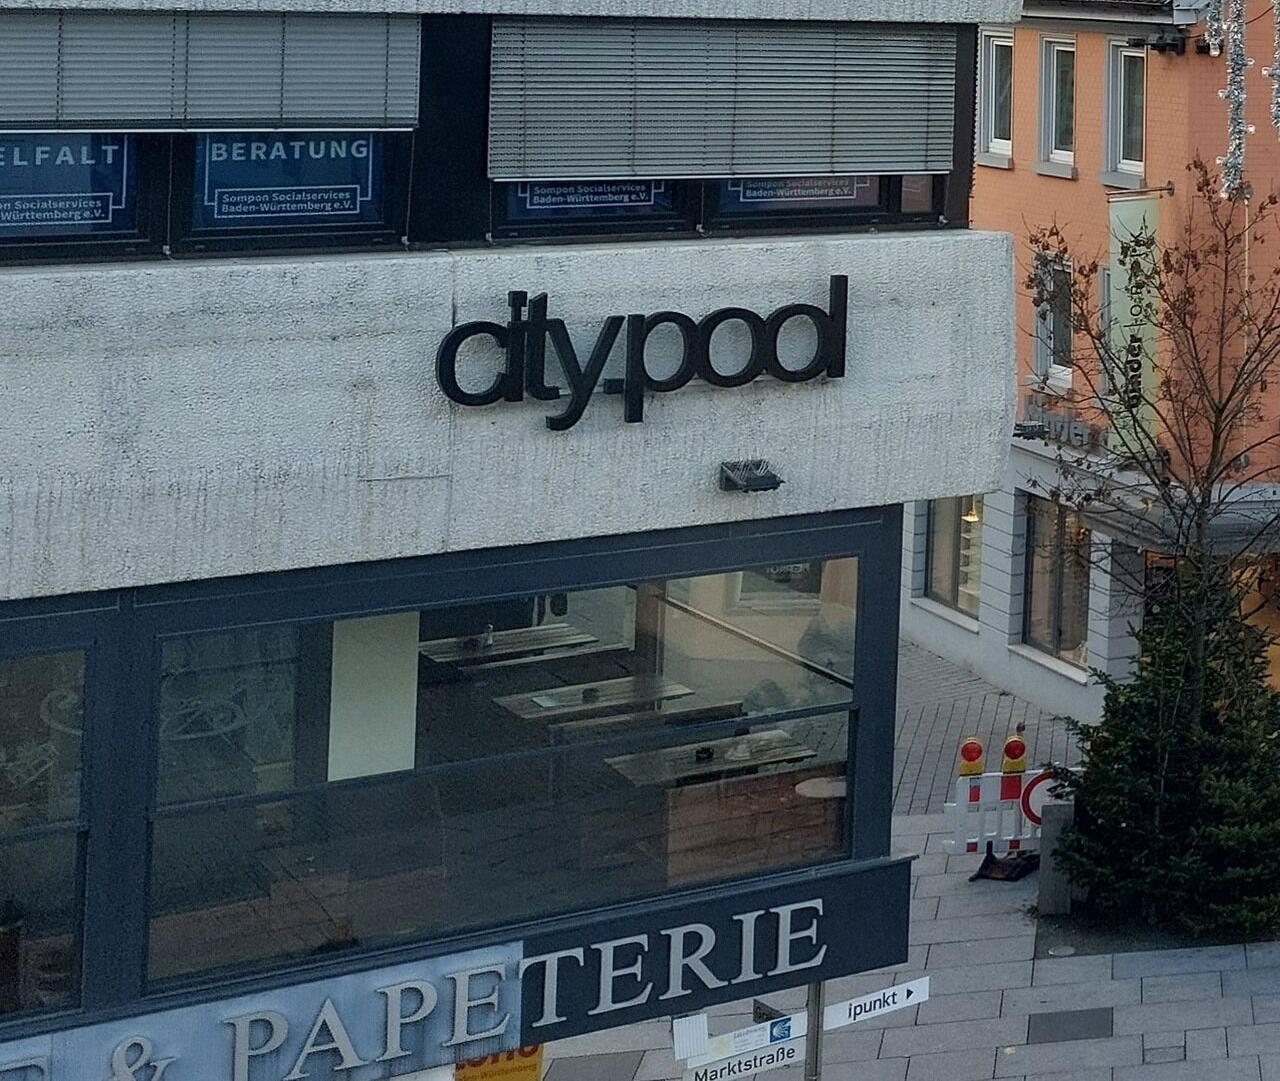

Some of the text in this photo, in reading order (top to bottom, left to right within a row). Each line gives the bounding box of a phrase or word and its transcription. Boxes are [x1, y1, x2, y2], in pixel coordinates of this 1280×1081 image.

[211, 138, 369, 162] BERATUNG
[577, 182, 647, 193] Socialservices
[745, 186, 836, 198] Baden-Württemberg
[271, 190, 352, 202] Socialservices
[532, 191, 649, 204] Baden-Württemberg e.V.
[14, 199, 103, 210] Socialservices
[221, 201, 333, 213] Baden-Württemberg
[0, 210, 81, 221] Württemberg
[223, 897, 829, 1081] PAPETERIE
[847, 990, 898, 1024] ipunkt
[694, 1046, 796, 1081] Marktstraße
